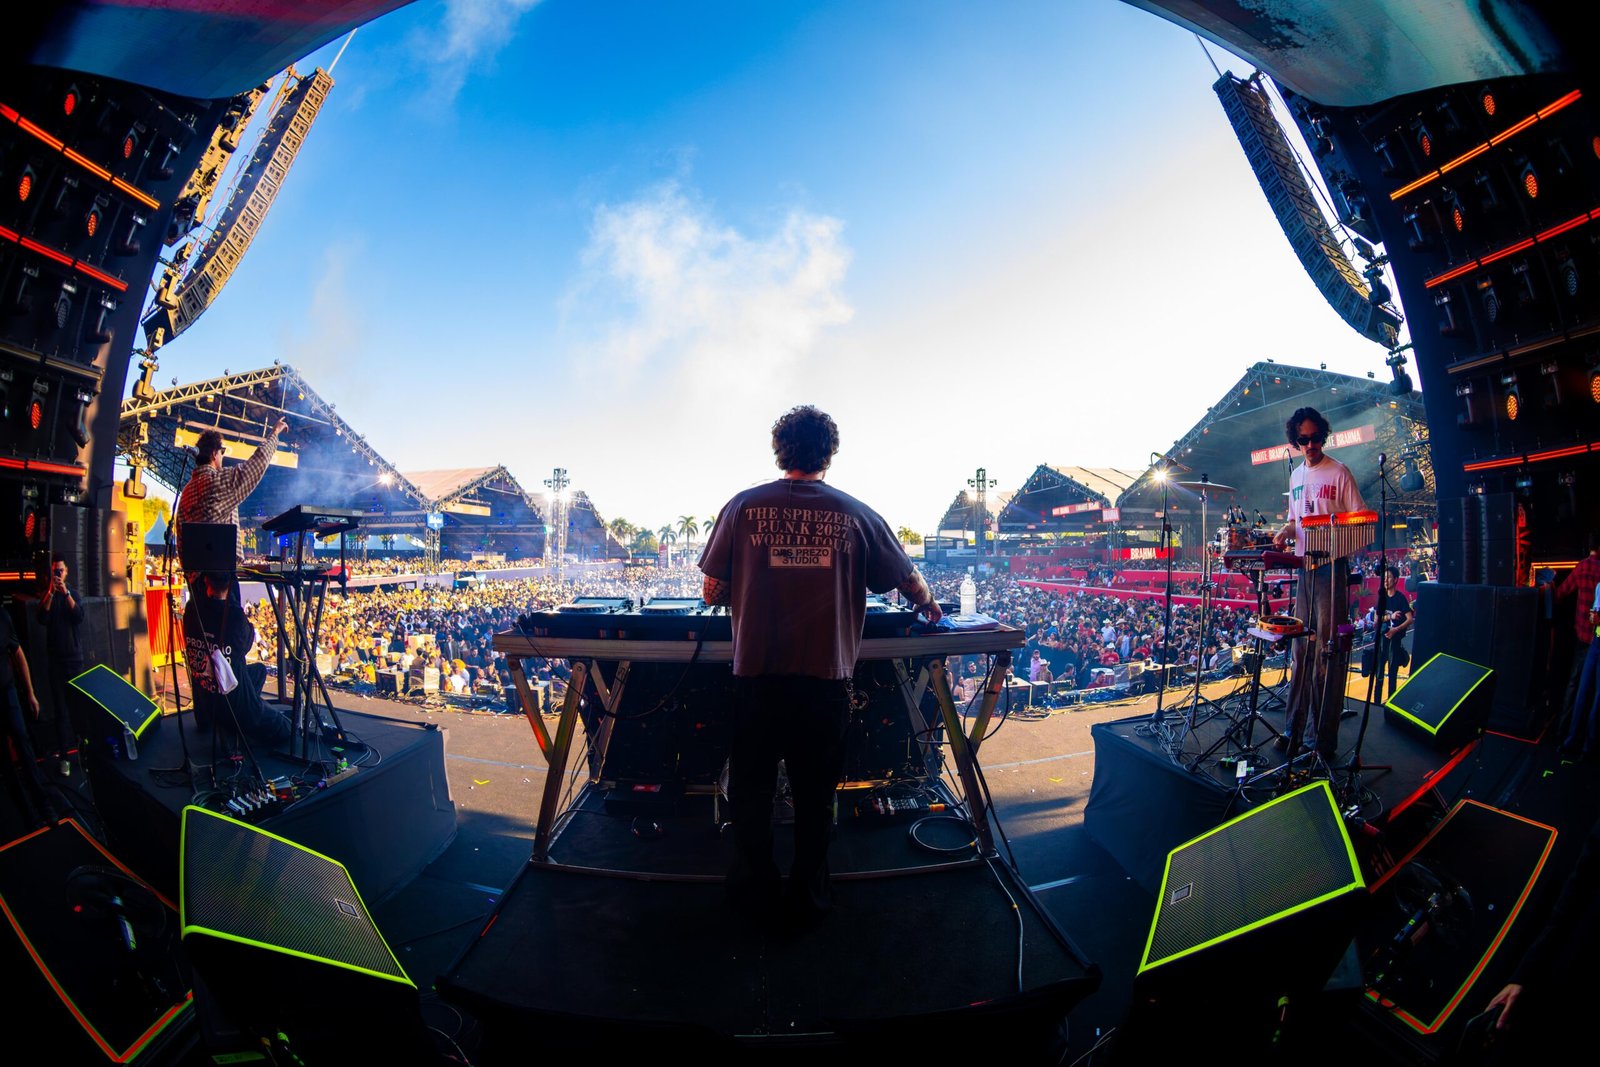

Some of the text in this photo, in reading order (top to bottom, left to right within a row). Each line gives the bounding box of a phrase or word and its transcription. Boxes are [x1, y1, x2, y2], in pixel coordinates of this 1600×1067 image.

[745, 507, 860, 530] THE SPREZERS
[815, 523, 849, 539] 2027
[749, 533, 852, 554] WORLD TOUR
[796, 548, 829, 558] PREZO
[1130, 547, 1157, 560] BRAHMA
[782, 556, 820, 565] STUDIO
